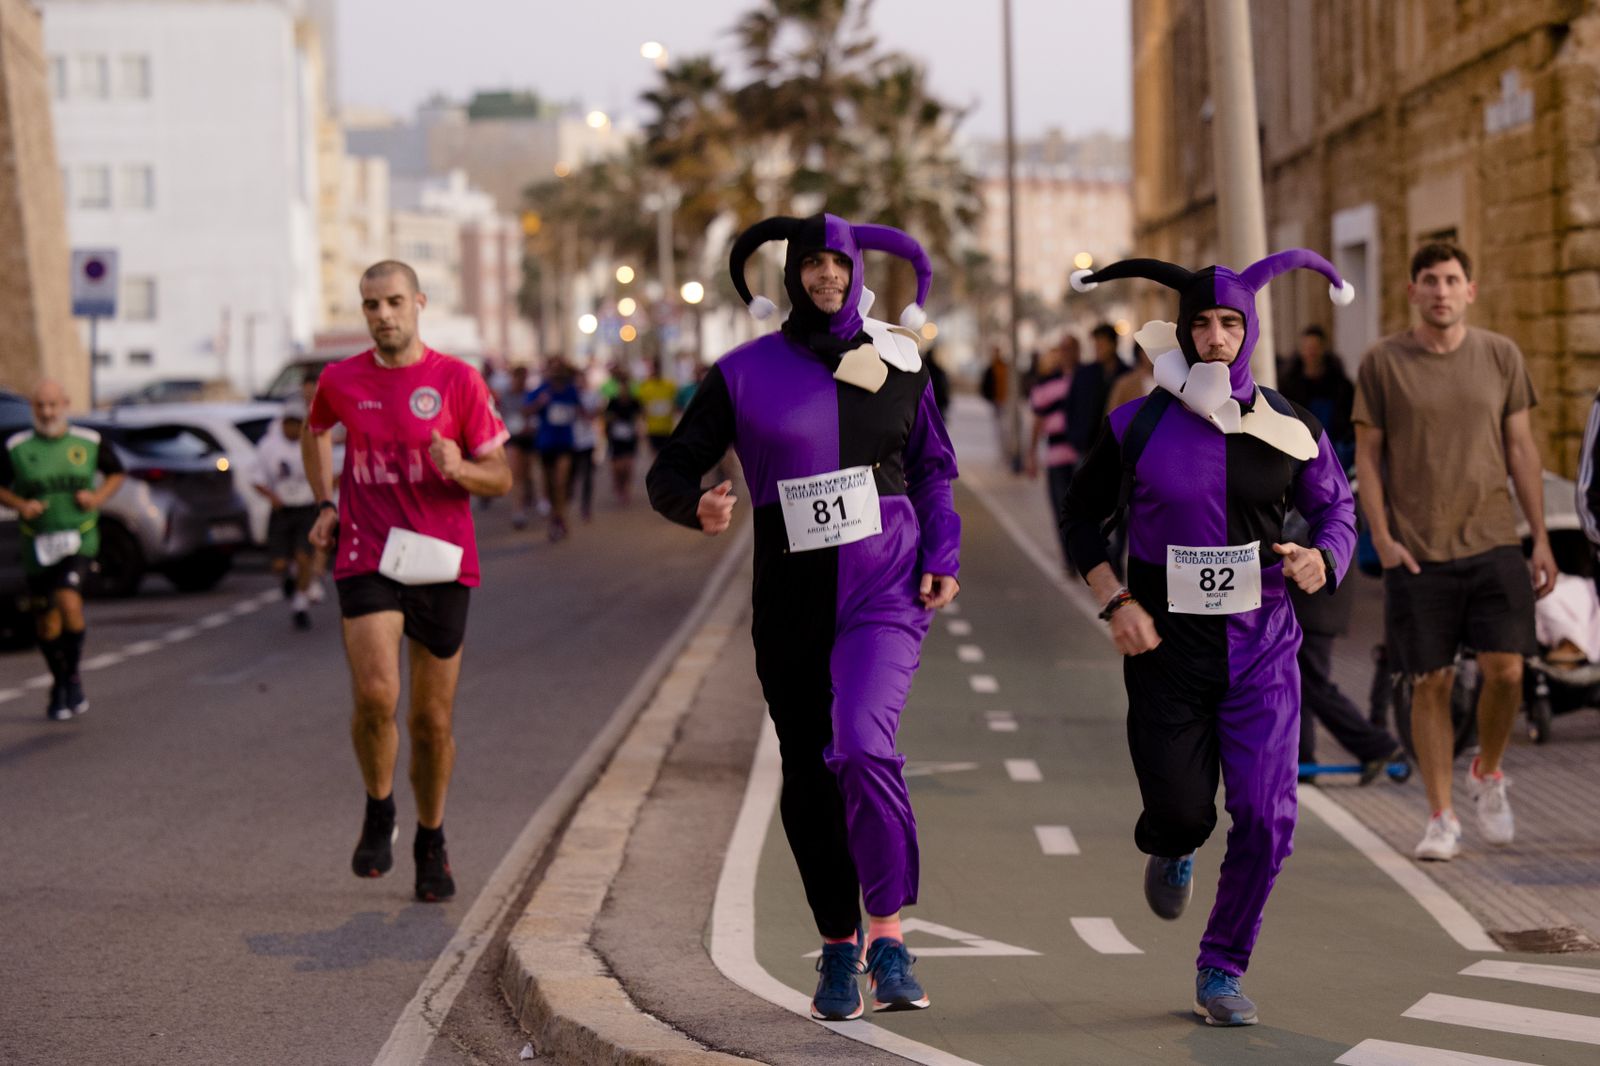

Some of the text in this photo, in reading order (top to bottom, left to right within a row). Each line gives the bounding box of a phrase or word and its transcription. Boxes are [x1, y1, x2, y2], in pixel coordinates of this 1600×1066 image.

[784, 472, 866, 492] SAN SILVESTRE
[786, 487, 823, 500] CIUDAD
[824, 484, 836, 495] DE
[812, 495, 847, 525] 81
[832, 519, 862, 531] ALMEIDA
[1174, 546, 1255, 557] SAN SILVESTRE
[1175, 555, 1213, 565] CIUDAD
[1215, 556, 1227, 565] DE
[1199, 567, 1235, 592] 82
